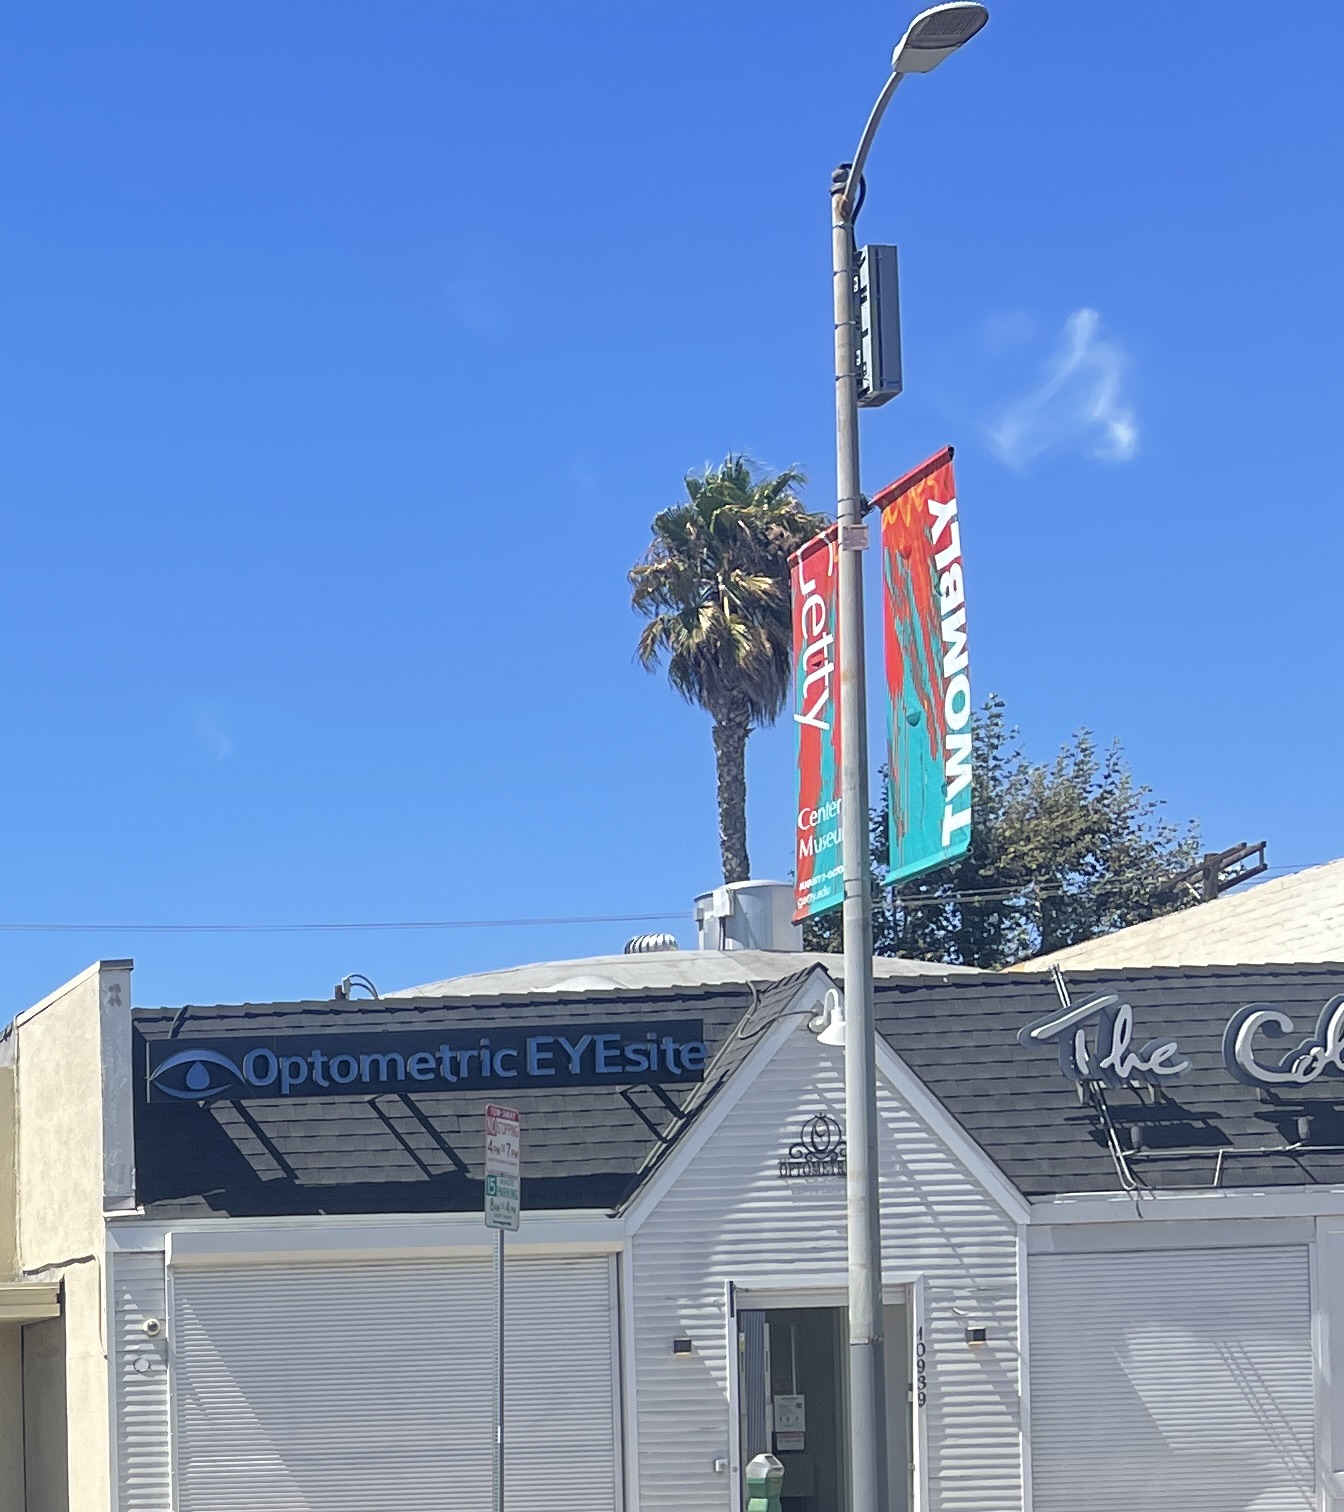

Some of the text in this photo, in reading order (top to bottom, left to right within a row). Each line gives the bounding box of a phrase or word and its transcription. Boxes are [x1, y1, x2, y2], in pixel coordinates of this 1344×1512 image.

[794, 530, 835, 731] Getty
[927, 498, 972, 846] TWOMBLY
[798, 798, 842, 831] Center
[799, 827, 844, 860] Museu
[243, 1031, 707, 1094] Optometric EYEsite
[1031, 995, 1189, 1077] The
